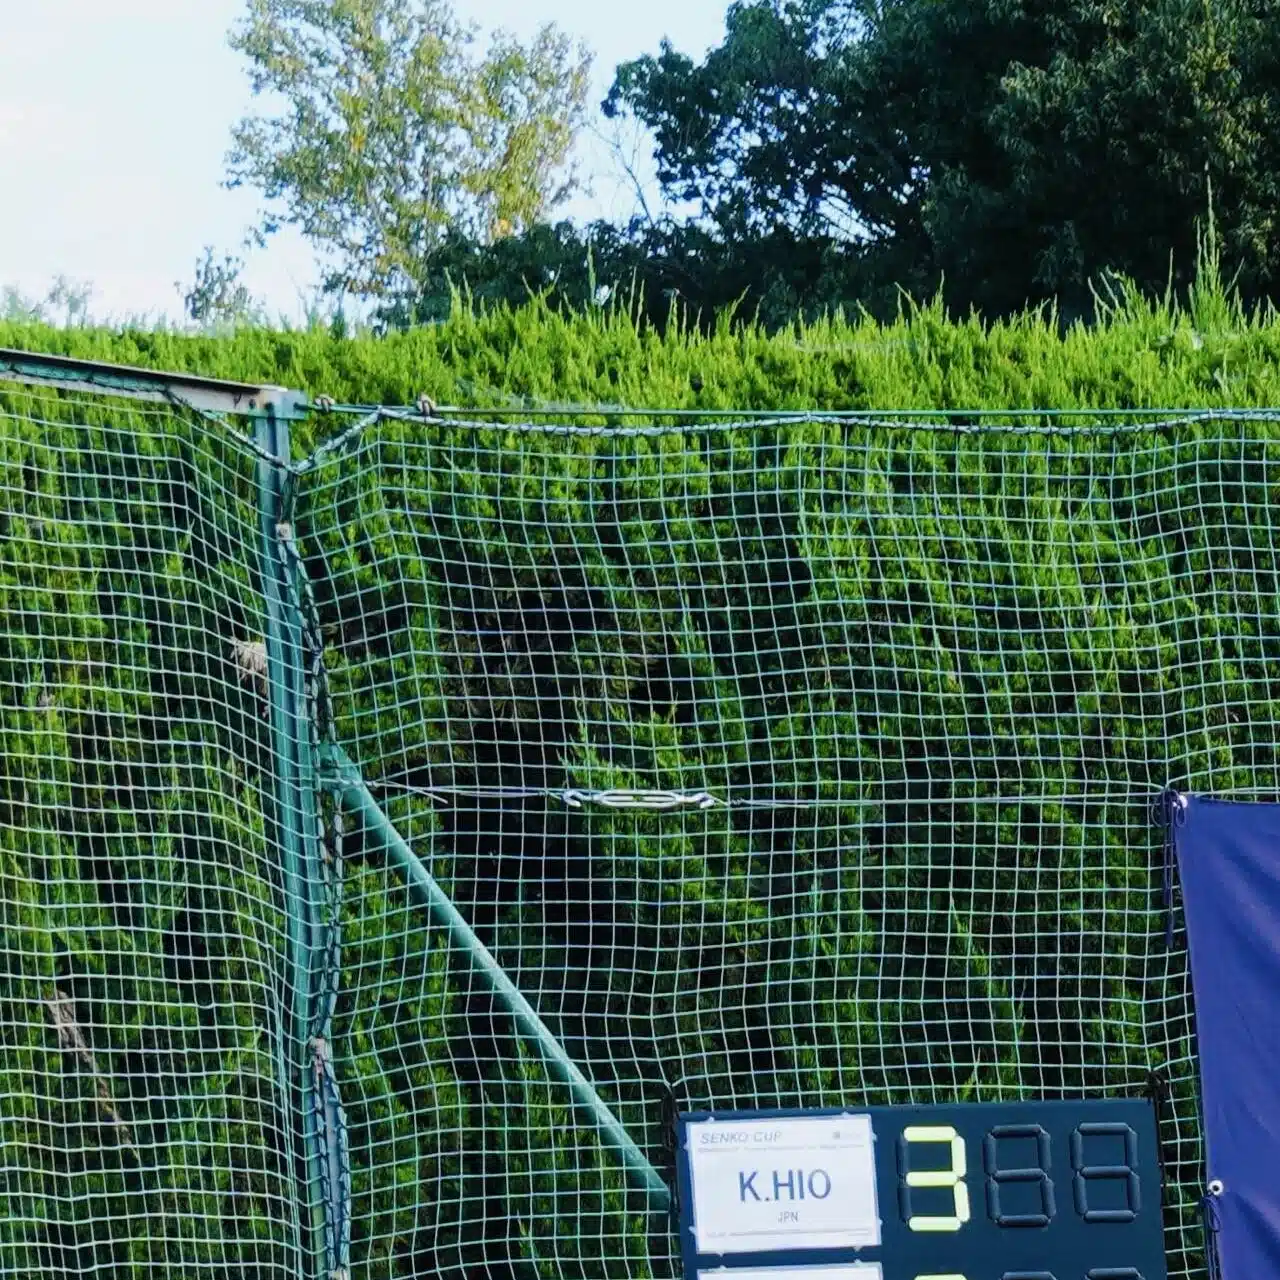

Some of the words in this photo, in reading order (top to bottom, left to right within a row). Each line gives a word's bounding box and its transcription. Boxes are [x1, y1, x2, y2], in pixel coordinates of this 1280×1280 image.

[700, 1132, 749, 1145] SENKO
[753, 1131, 783, 1143] CUP
[738, 1168, 832, 1202] K.HIO
[903, 1125, 971, 1232] 3
[777, 1211, 799, 1224] JPN
